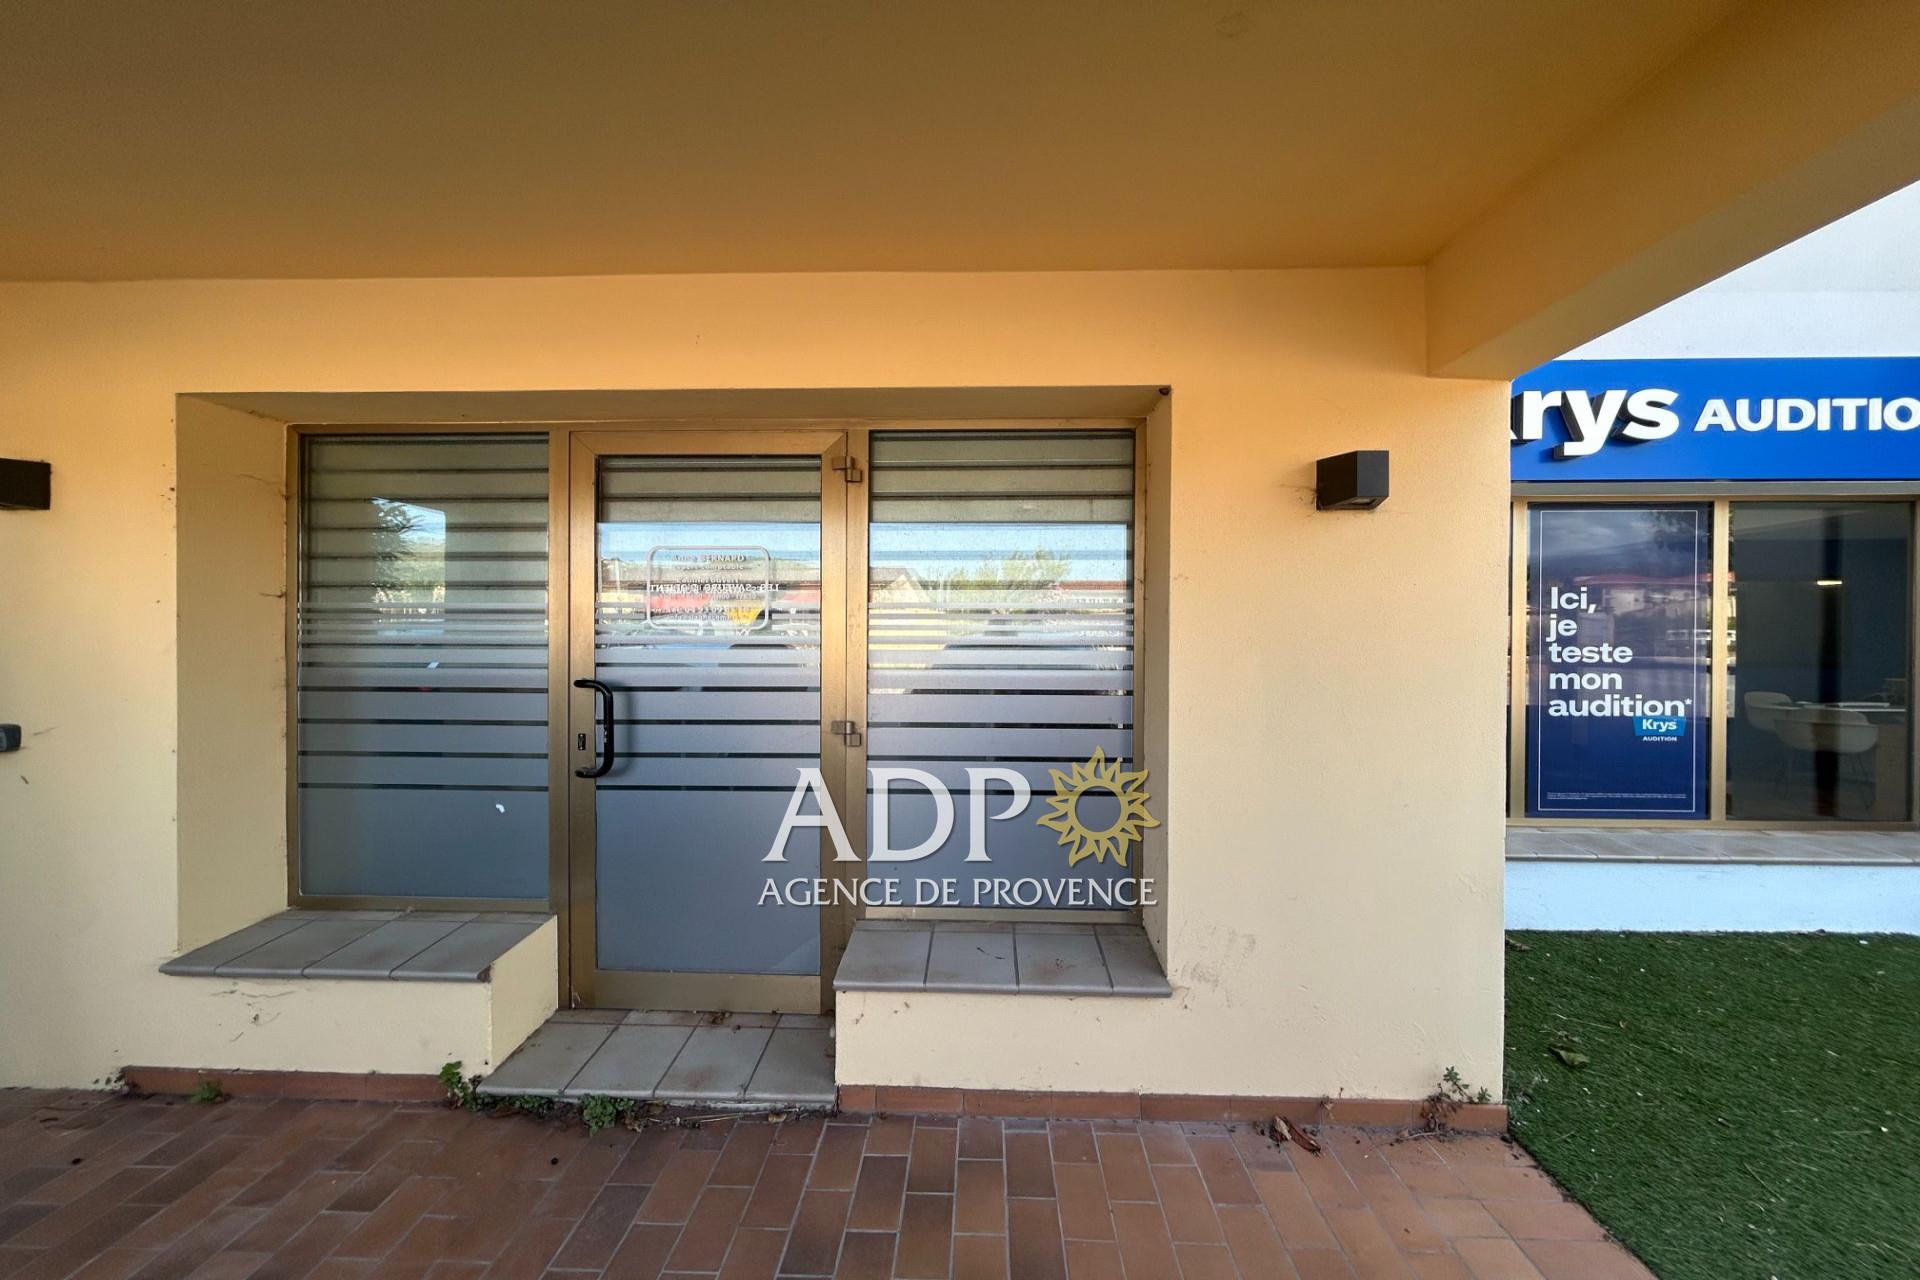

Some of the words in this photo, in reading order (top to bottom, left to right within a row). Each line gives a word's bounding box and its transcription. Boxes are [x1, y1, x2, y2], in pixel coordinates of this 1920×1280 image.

[1511, 388, 1680, 456] rys
[1551, 586, 1597, 614] Ici,
[1546, 614, 1578, 642] je
[1549, 643, 1633, 663] teste
[1549, 672, 1623, 690] mon
[1642, 719, 1677, 732] Krys
